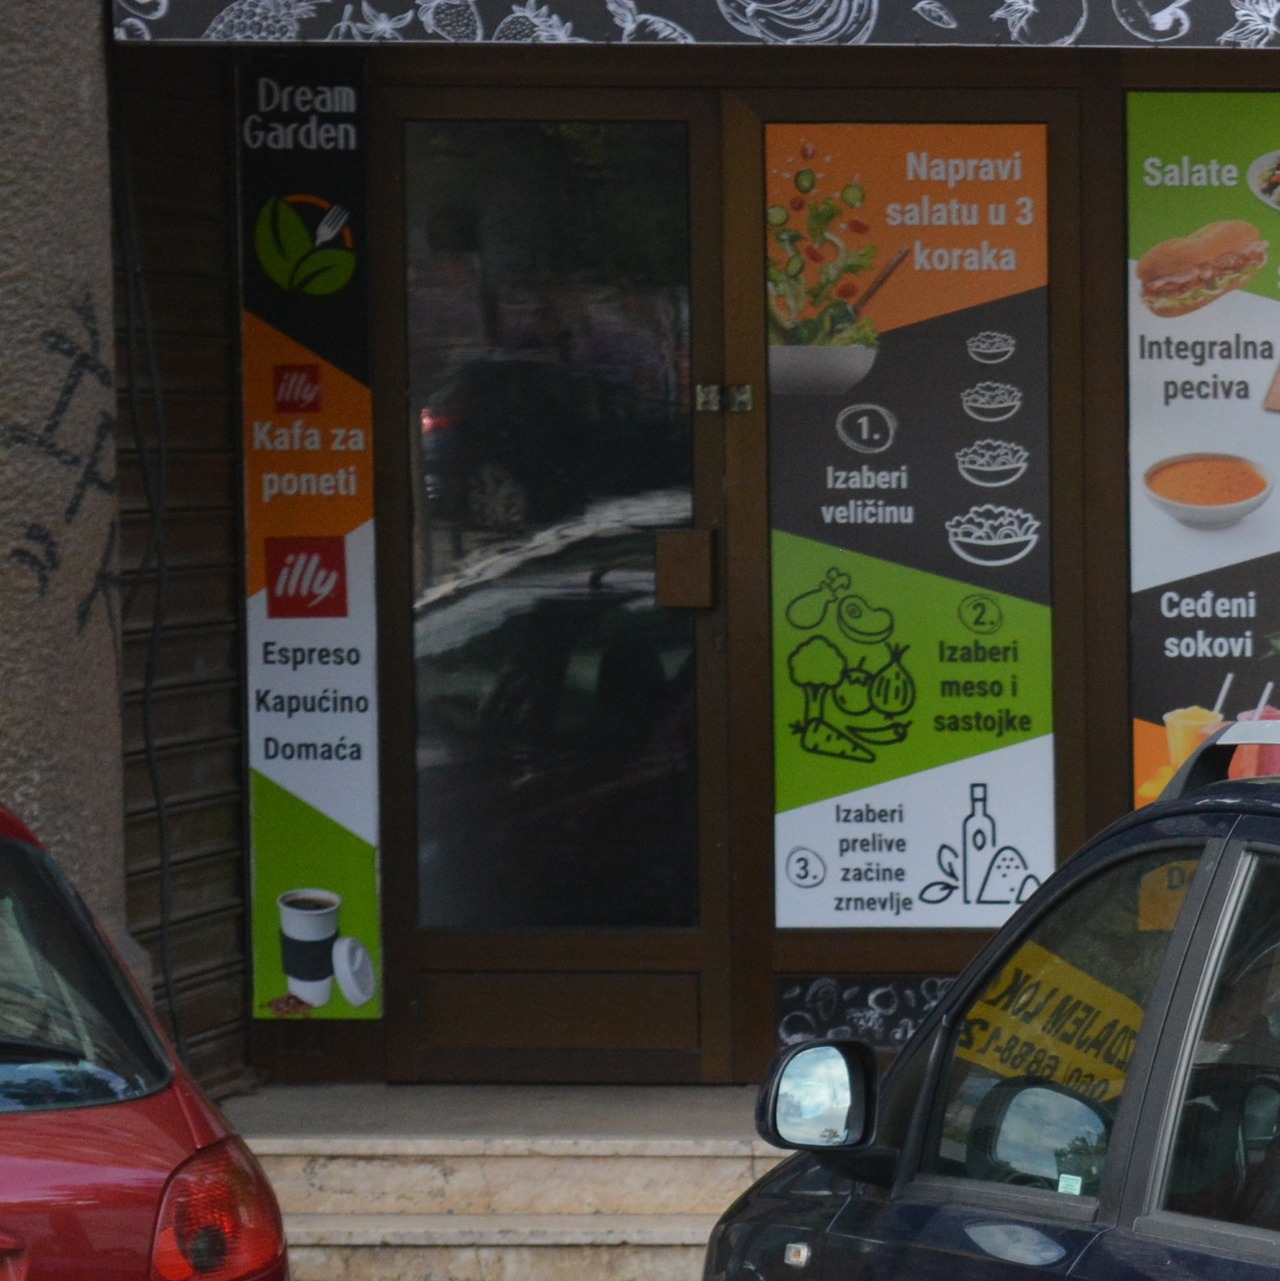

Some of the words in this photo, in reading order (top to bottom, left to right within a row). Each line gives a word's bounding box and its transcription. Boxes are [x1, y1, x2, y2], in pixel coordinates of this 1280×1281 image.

[257, 77, 357, 113] Dream
[243, 114, 357, 150] Garden
[906, 151, 1023, 187] Napravi
[1143, 156, 1239, 188] Salate
[886, 198, 979, 227] salatu
[987, 206, 1006, 227] u
[1015, 198, 1035, 227] 3
[914, 242, 1017, 273] koraka
[1138, 333, 1274, 369] Integralna
[277, 371, 320, 408] illy
[1163, 374, 1250, 406] peciva
[252, 420, 323, 451] Kafa
[330, 428, 366, 452] za
[855, 416, 881, 442] 1.
[262, 467, 357, 502] poneti
[826, 464, 908, 491] Izaberi
[820, 497, 914, 525] veličinu
[275, 553, 339, 607] illy
[970, 603, 998, 629] 2.
[1160, 591, 1256, 620] Ceđeni
[262, 641, 362, 671] Espreso
[937, 641, 1020, 665] Izaberi
[1163, 631, 1254, 660] sokovi
[939, 677, 1006, 699] meso
[1010, 675, 1019, 699] i
[254, 688, 370, 718] Kapućino
[932, 709, 1033, 737] sastojke
[262, 735, 363, 763] Domaća
[834, 804, 905, 825] Izaberi
[839, 832, 907, 858] prelive
[794, 857, 820, 881] 3.
[840, 860, 906, 885] začine
[833, 889, 914, 916] zrnevlje
